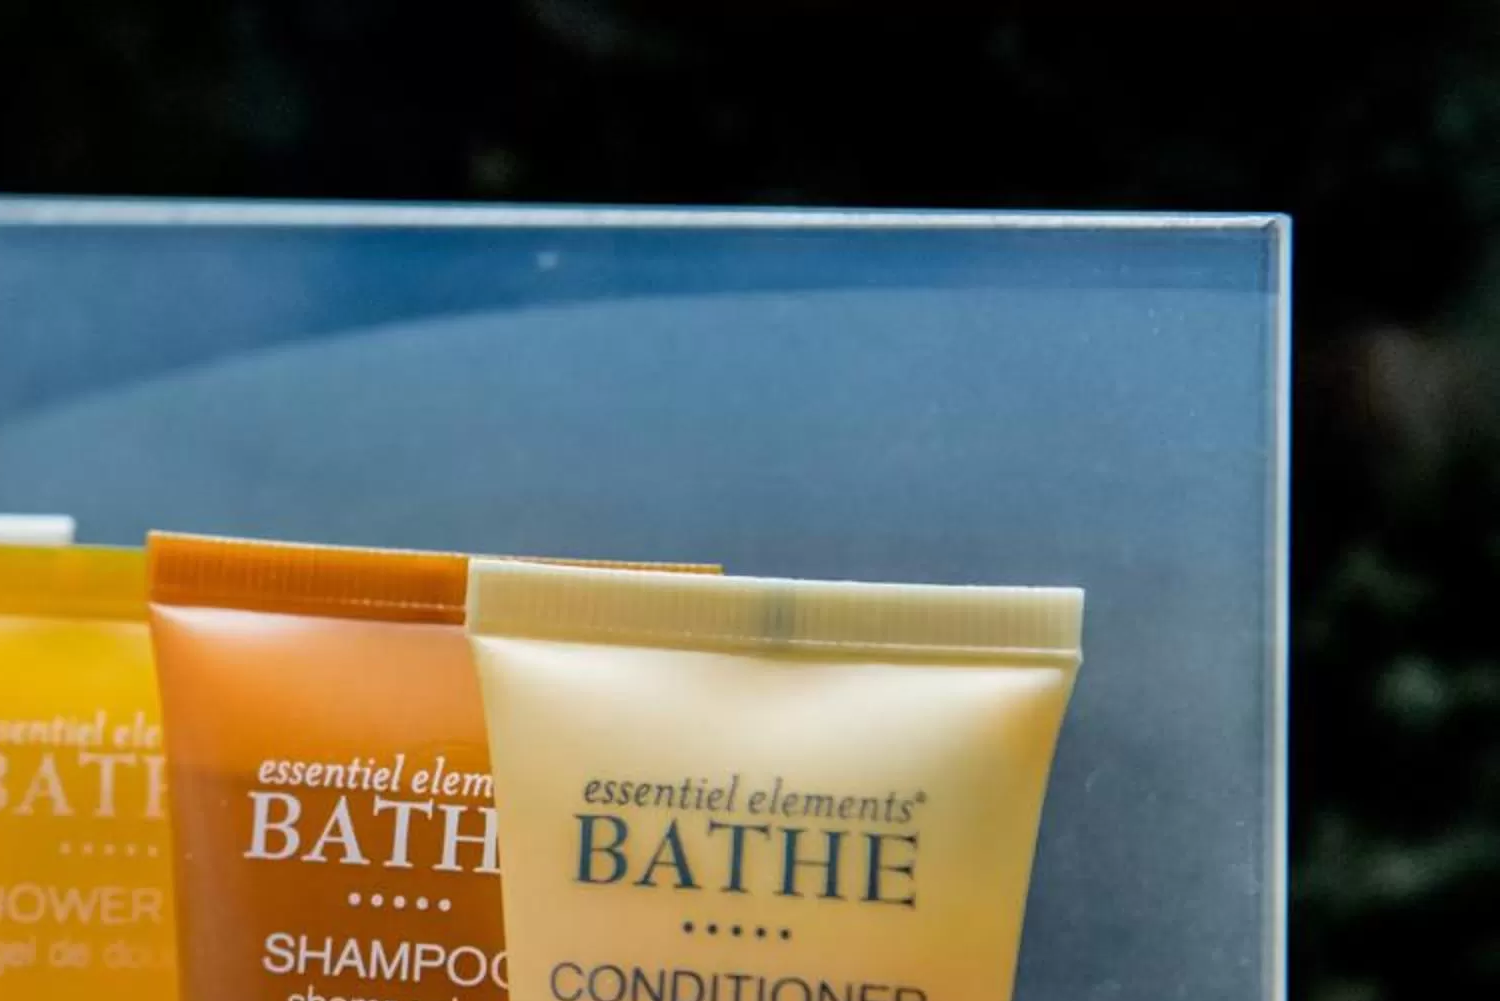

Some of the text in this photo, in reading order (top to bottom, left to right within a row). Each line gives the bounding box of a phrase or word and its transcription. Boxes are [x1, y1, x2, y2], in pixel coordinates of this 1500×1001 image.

[257, 753, 495, 798] essentiel elem
[583, 774, 737, 814] essentiel
[243, 790, 501, 875] BATH
[571, 813, 920, 909] BATHE
[262, 932, 510, 991] SHAMPO
